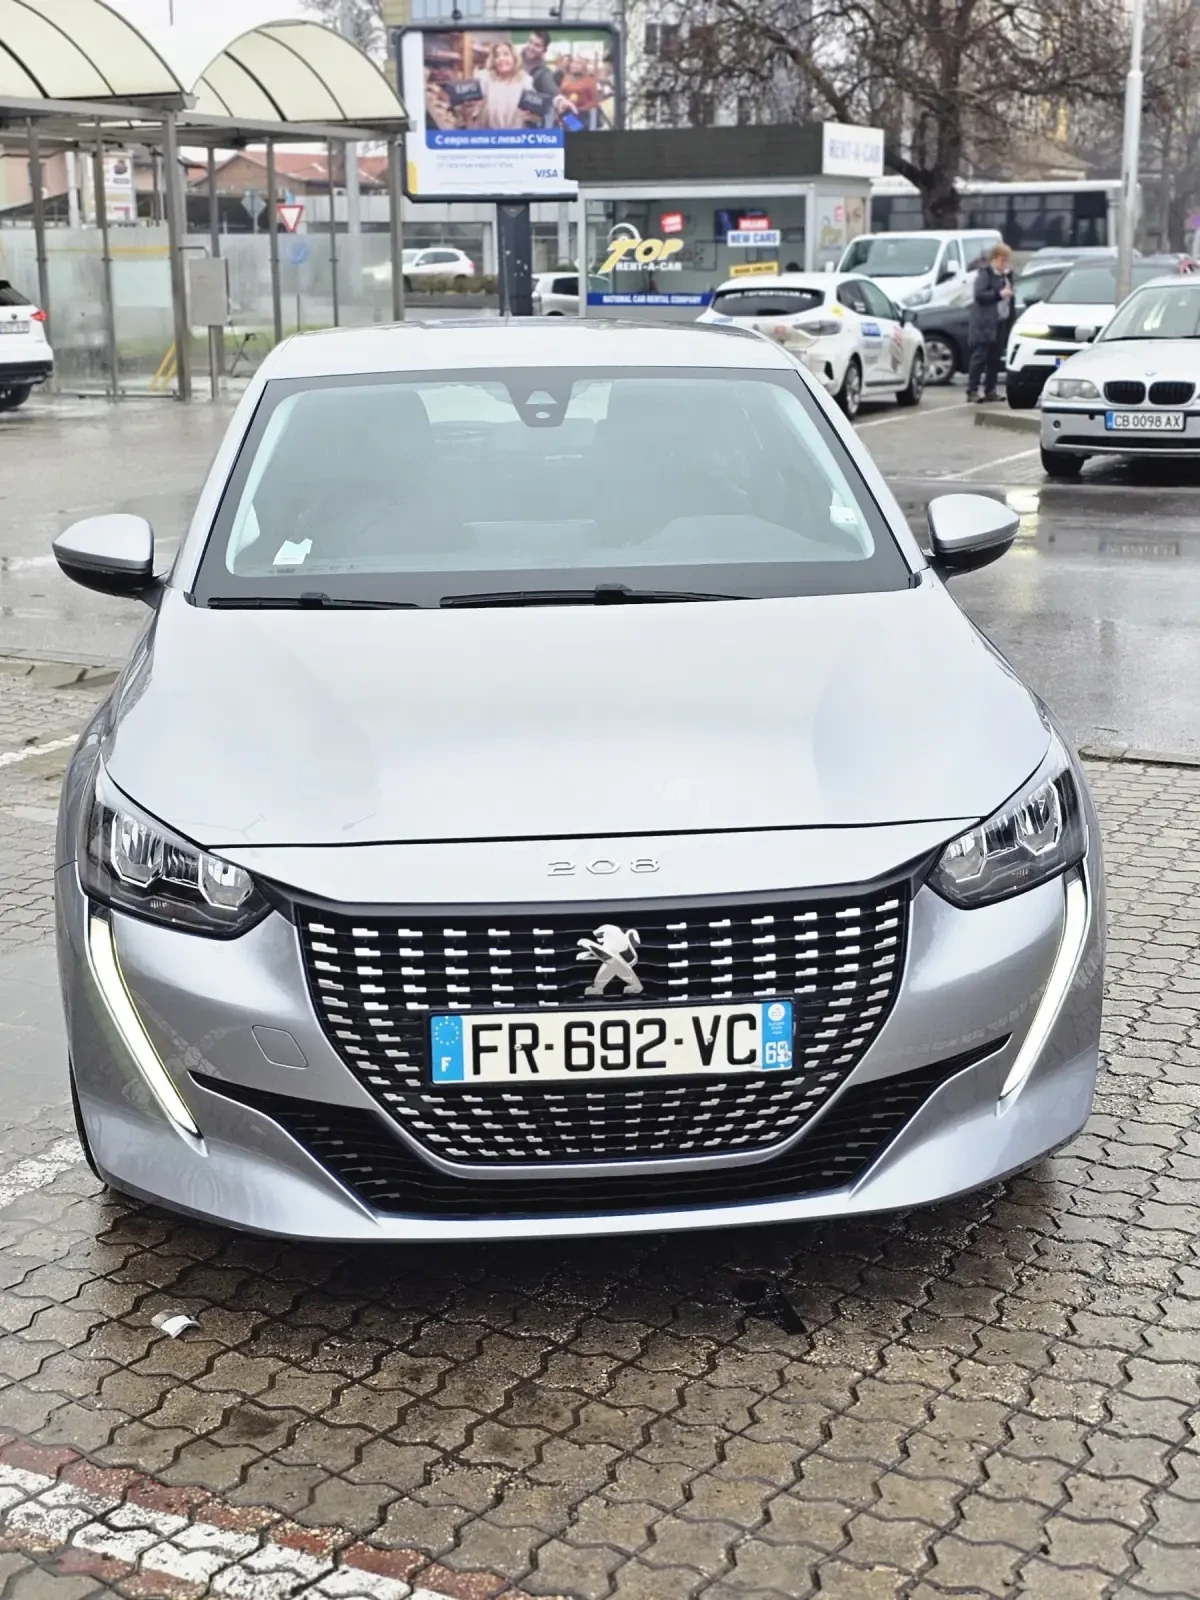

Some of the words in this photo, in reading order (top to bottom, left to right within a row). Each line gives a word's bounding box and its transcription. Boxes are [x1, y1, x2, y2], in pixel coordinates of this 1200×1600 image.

[536, 133, 558, 144] Visa
[534, 168, 559, 178] VISA
[730, 233, 750, 244] NEW
[753, 233, 777, 244] CARS
[597, 237, 685, 275] TOP
[615, 261, 683, 271] RENT-A-CAR
[602, 295, 632, 304] NATIONAL
[632, 295, 646, 304] CAR
[646, 295, 670, 304] RENTAL
[670, 295, 702, 304] COMPANY
[1114, 414, 1130, 428] CB
[1132, 414, 1162, 428] 0098
[1164, 414, 1181, 428] AX
[547, 857, 661, 877] 208
[471, 1012, 757, 1076] FR-692-VC
[440, 1056, 452, 1073] F
